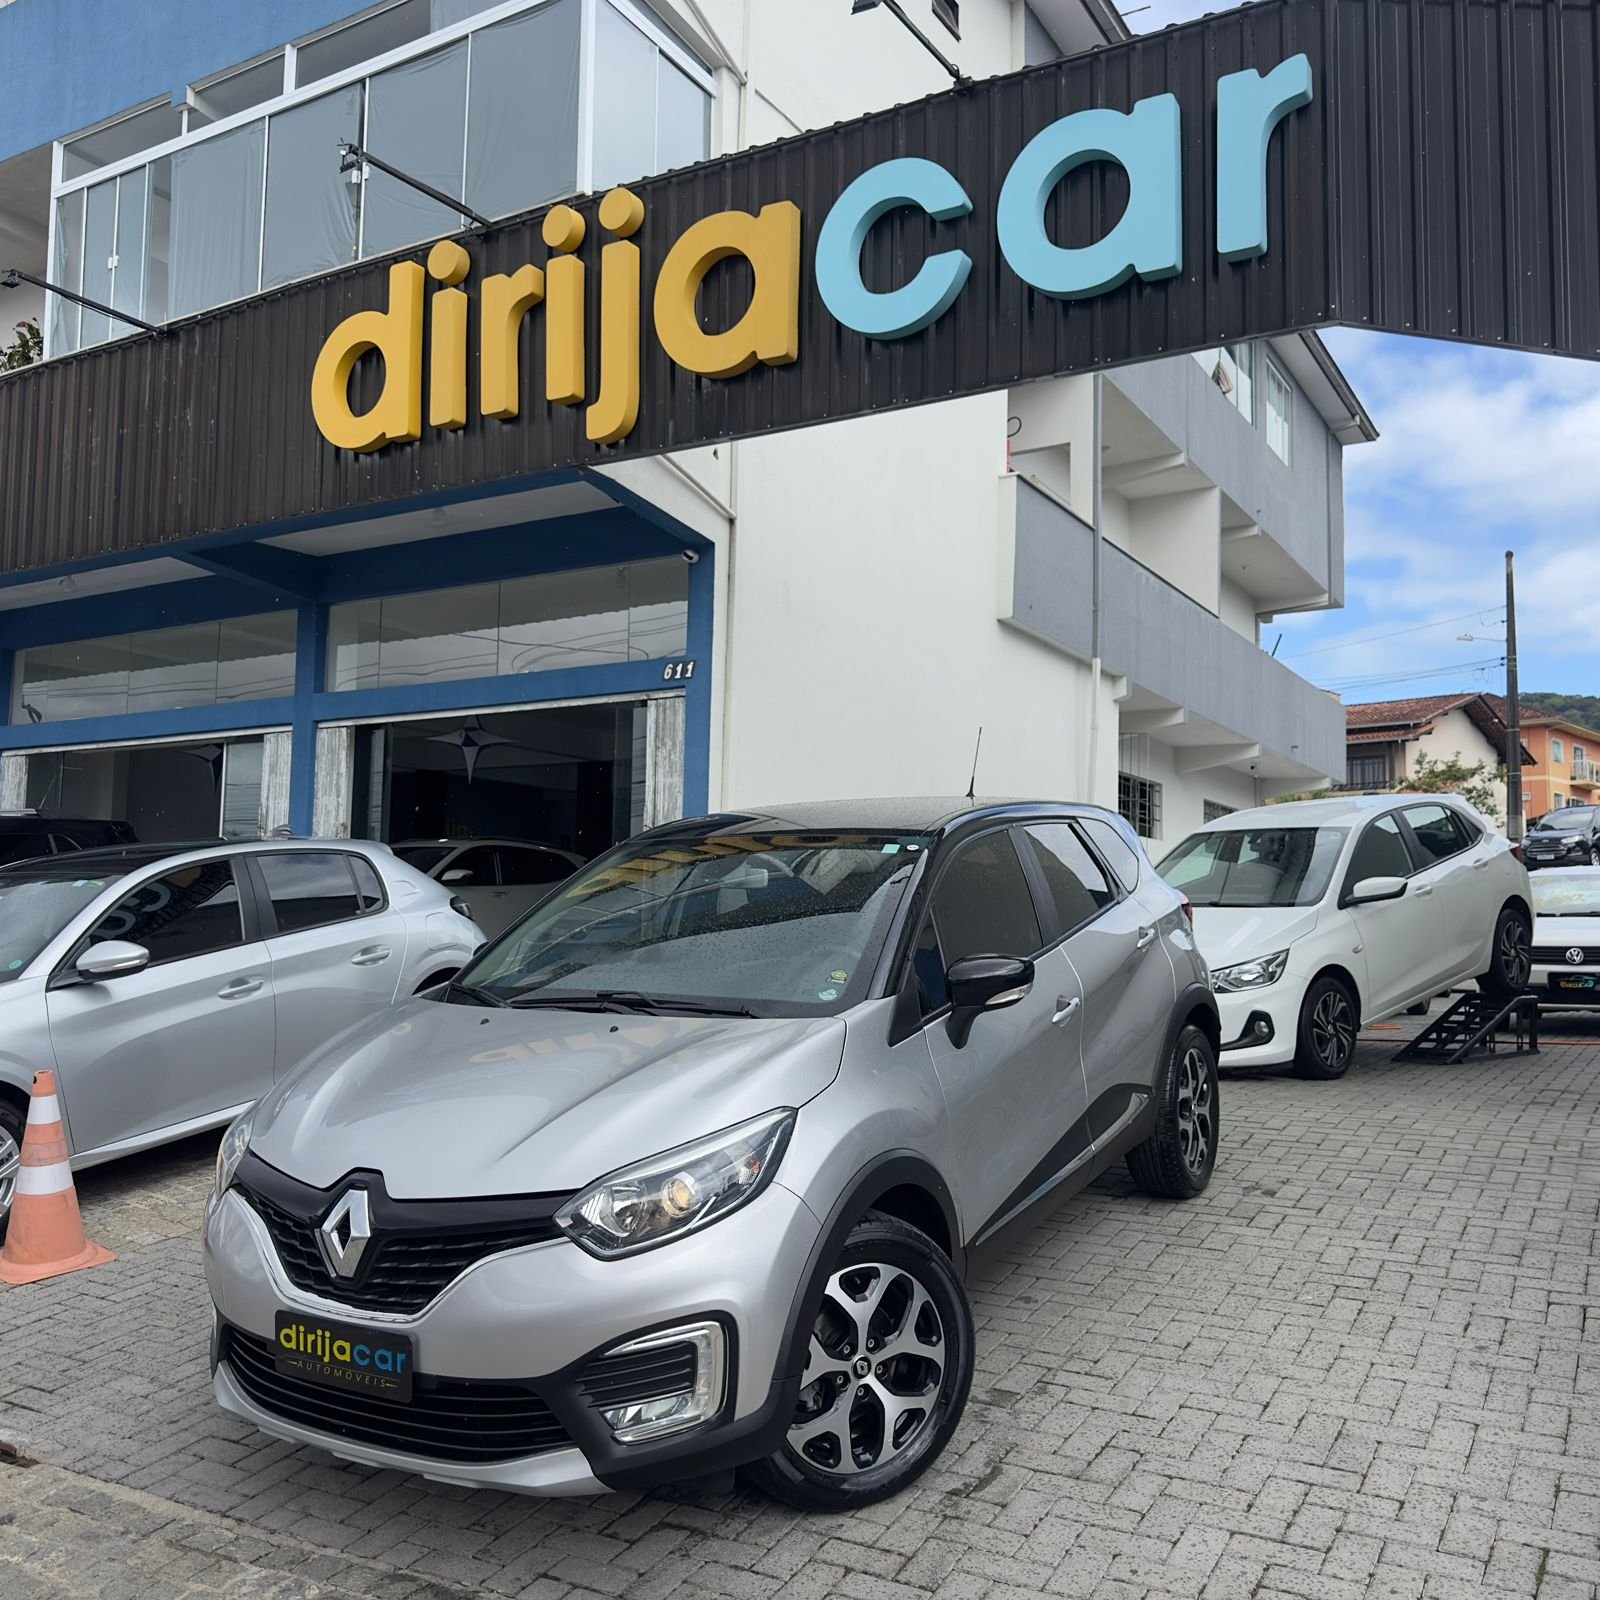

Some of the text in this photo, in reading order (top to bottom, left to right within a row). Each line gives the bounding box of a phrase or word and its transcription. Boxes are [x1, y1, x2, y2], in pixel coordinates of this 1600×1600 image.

[311, 52, 1313, 454] dirijacar
[663, 661, 694, 680] 611
[279, 1323, 406, 1374] dirijacar
[296, 1360, 387, 1388] AUTOMÓVEIS
